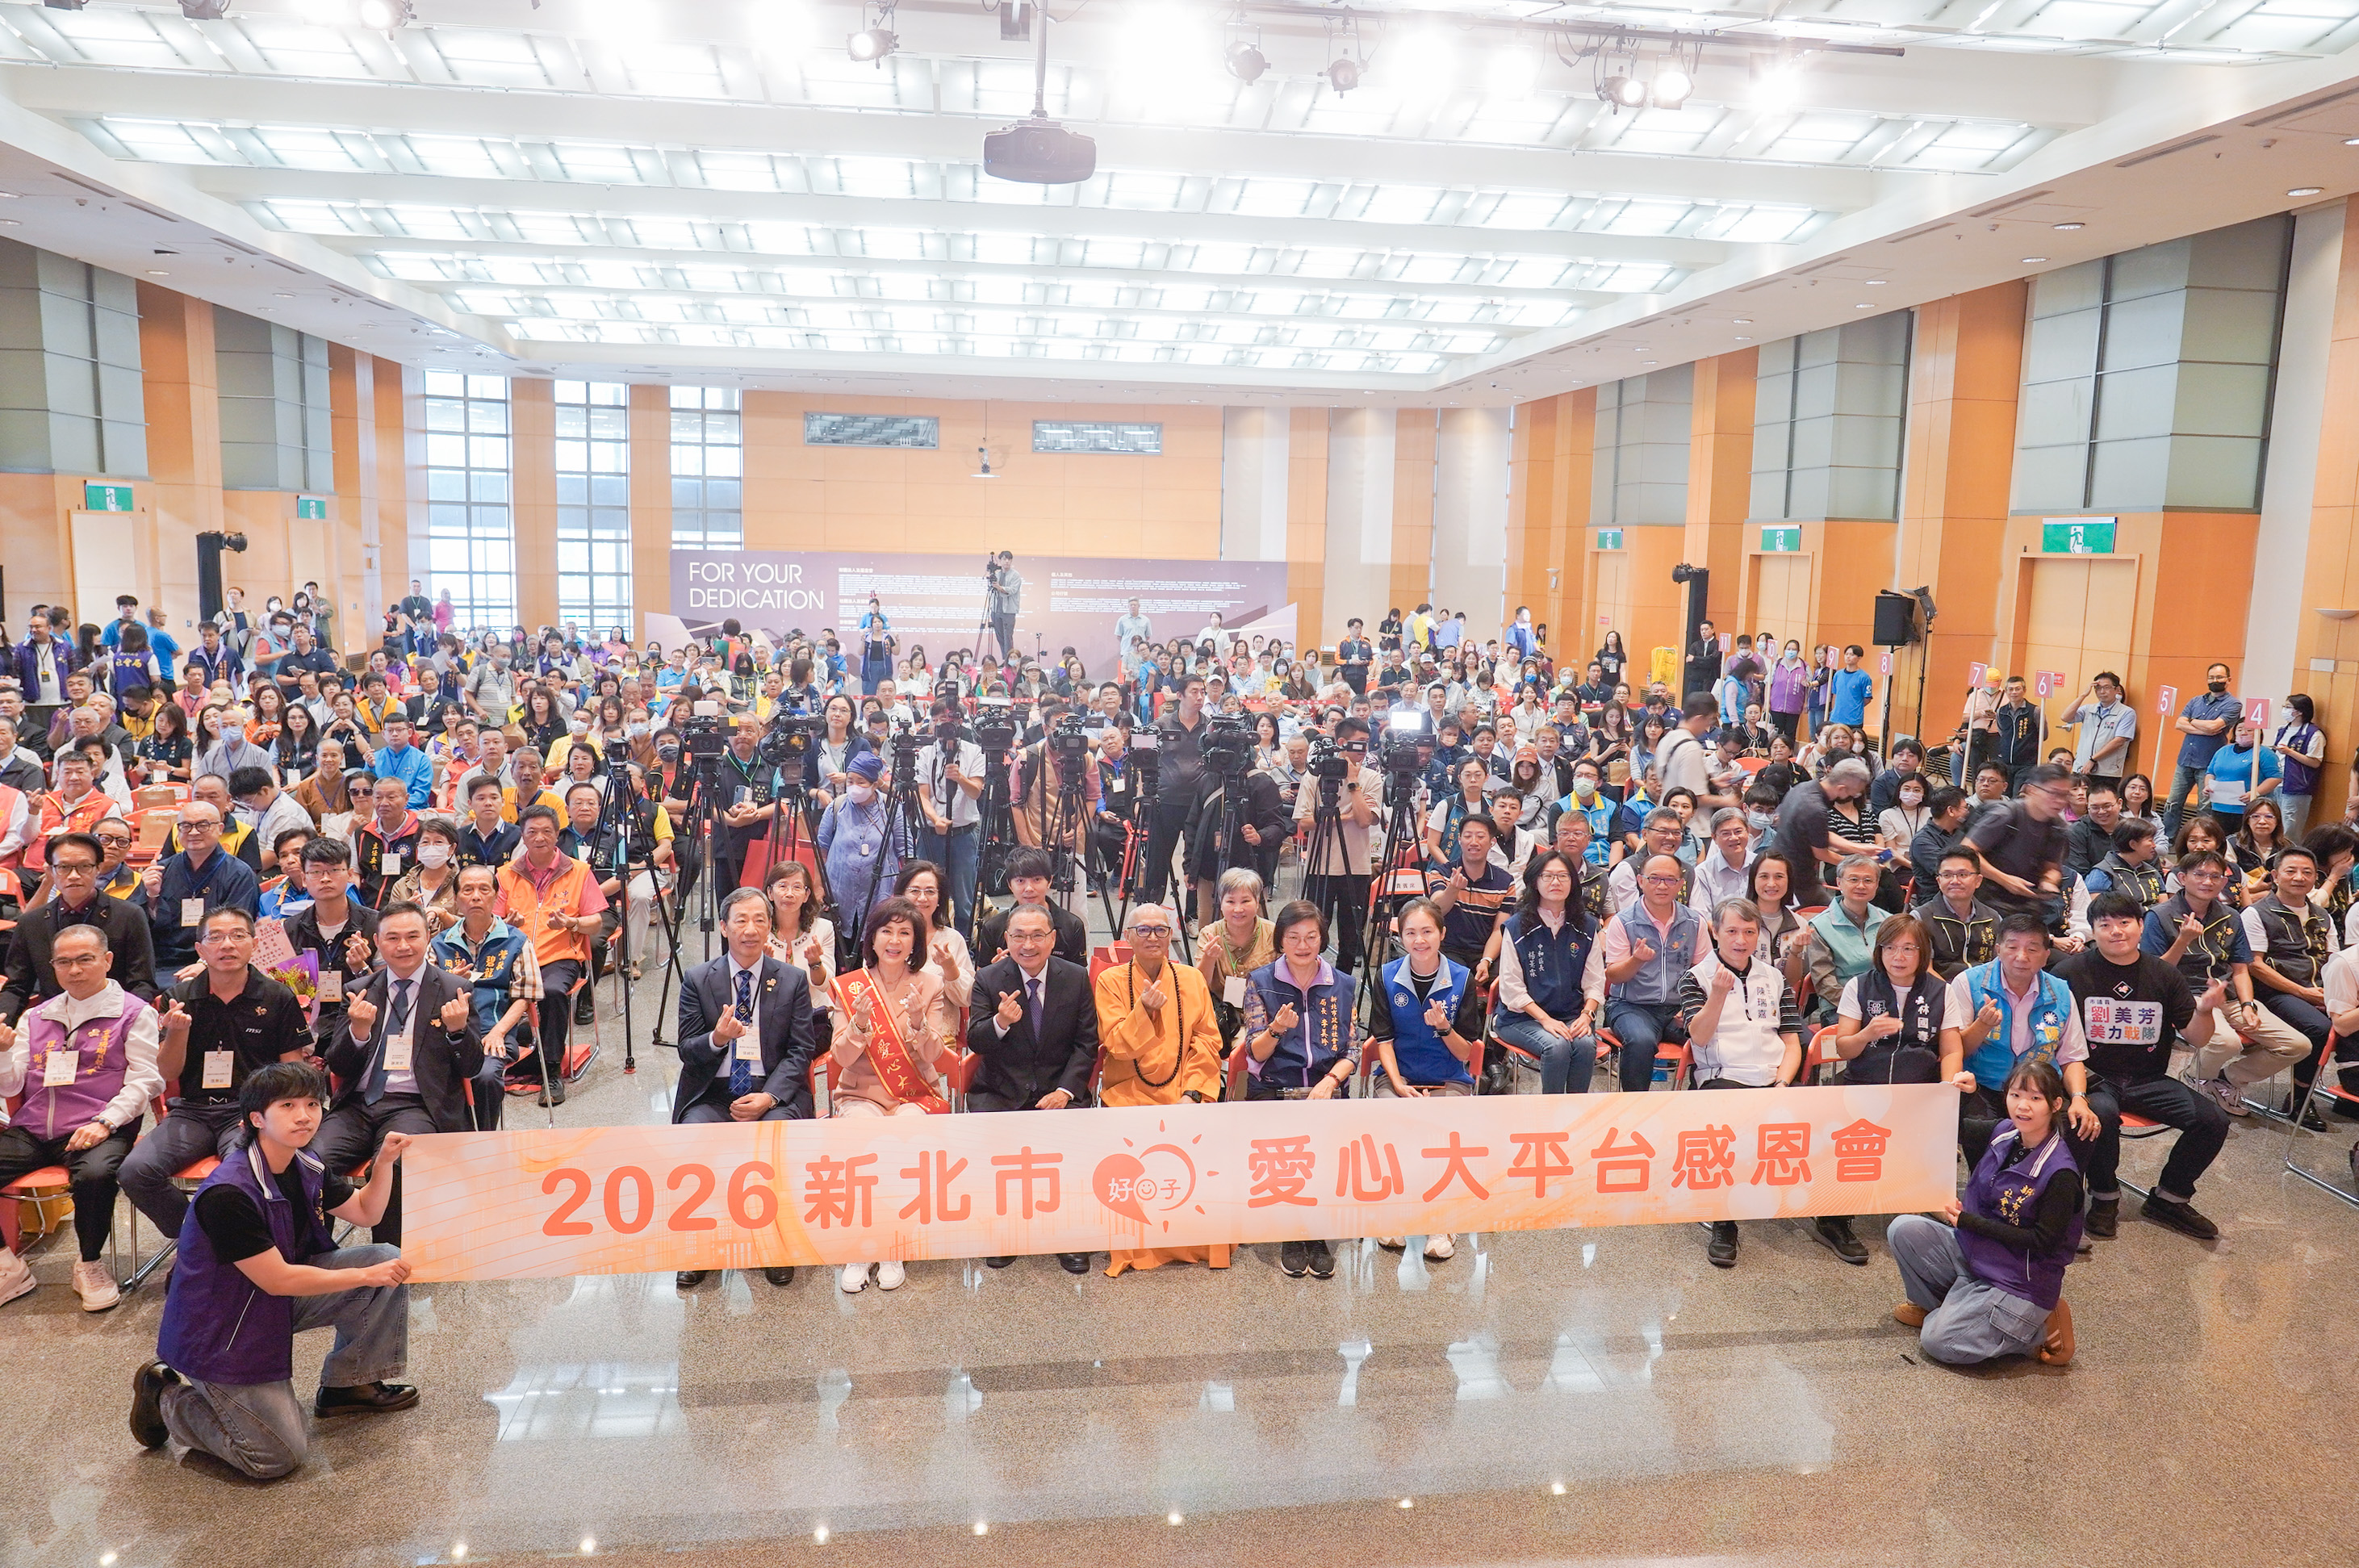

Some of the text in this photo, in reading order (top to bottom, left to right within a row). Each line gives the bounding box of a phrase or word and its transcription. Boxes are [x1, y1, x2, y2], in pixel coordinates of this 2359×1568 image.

[689, 562, 802, 583] FOR YOUR
[689, 587, 824, 610] DEDICATION
[1721, 636, 1727, 649] 11
[1767, 643, 1775, 657] 10
[1828, 652, 1834, 664] 9
[1881, 656, 1888, 673] 8
[1973, 667, 1980, 684] 7
[2038, 676, 2046, 695] 6
[2160, 691, 2169, 712] 5
[2250, 703, 2263, 725] 4
[1537, 943, 1545, 972] 中和區長
[1320, 998, 1328, 1015] 局長
[2090, 1006, 2156, 1026] 劉美芳
[1330, 995, 1339, 1052] 新北市政府社會局
[2089, 1024, 2156, 1041] 美力戰隊
[1247, 1118, 1893, 1209] 愛心大平台感恩會
[541, 1146, 1064, 1236] 2026 新北市
